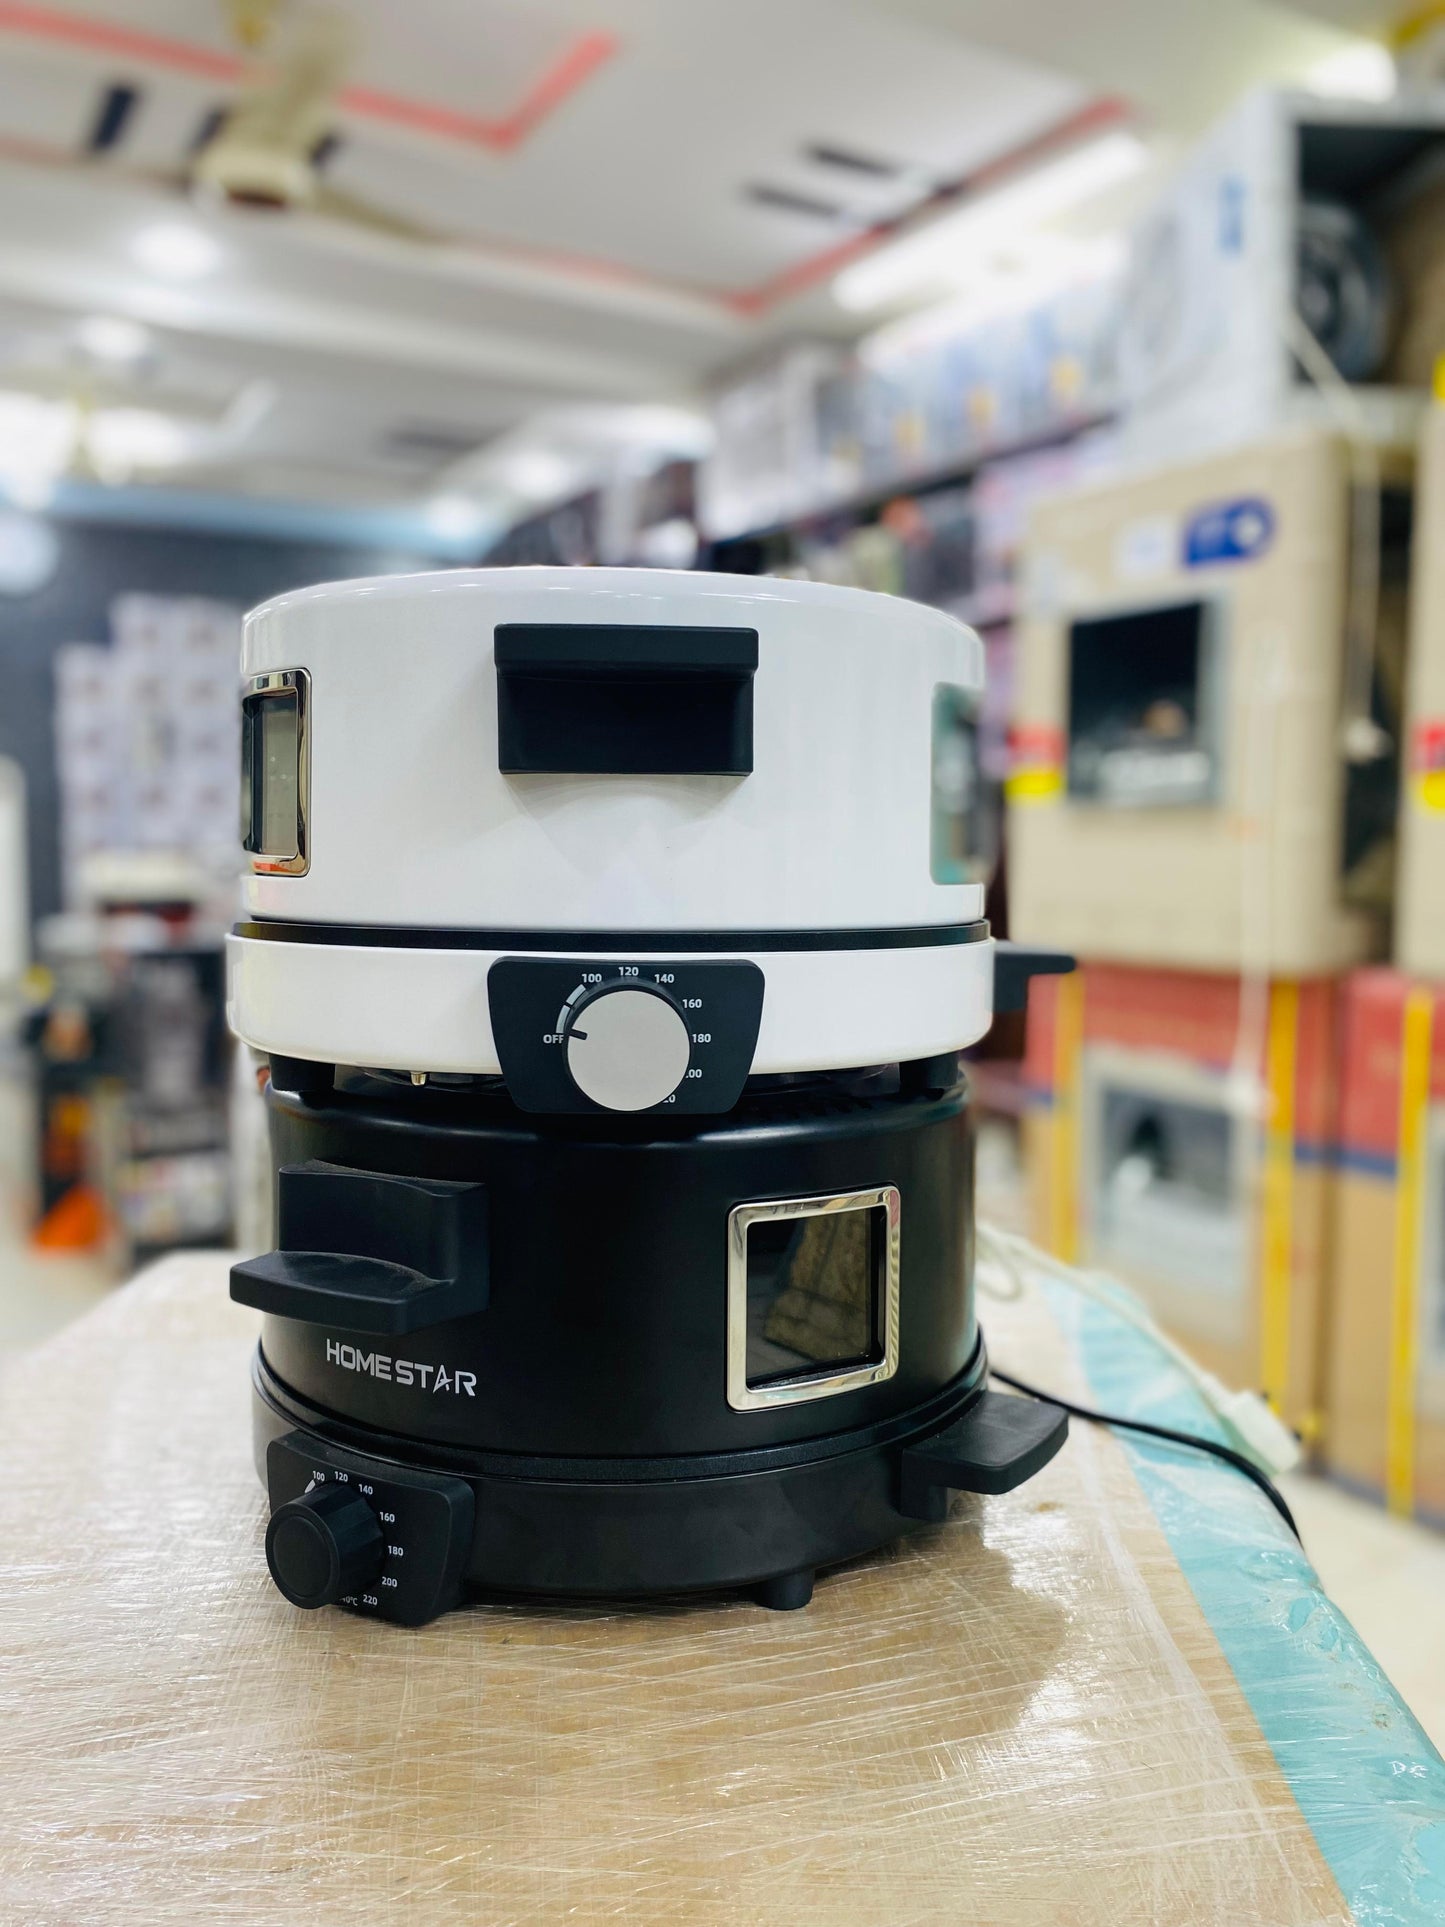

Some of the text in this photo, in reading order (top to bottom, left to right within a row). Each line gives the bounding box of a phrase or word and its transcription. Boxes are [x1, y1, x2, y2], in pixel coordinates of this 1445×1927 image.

[618, 966, 639, 977] 120
[581, 973, 602, 983] 100
[654, 973, 675, 984] 140
[682, 999, 702, 1009] 160
[543, 1034, 564, 1044] OFF
[692, 1033, 711, 1043] 180
[685, 1068, 703, 1079] 00
[312, 1470, 325, 1482] 100
[334, 1471, 348, 1483] 120
[358, 1483, 373, 1496] 140
[379, 1511, 395, 1523] 160
[387, 1545, 404, 1557] 180
[381, 1576, 398, 1588] 200
[362, 1594, 378, 1606] 220
